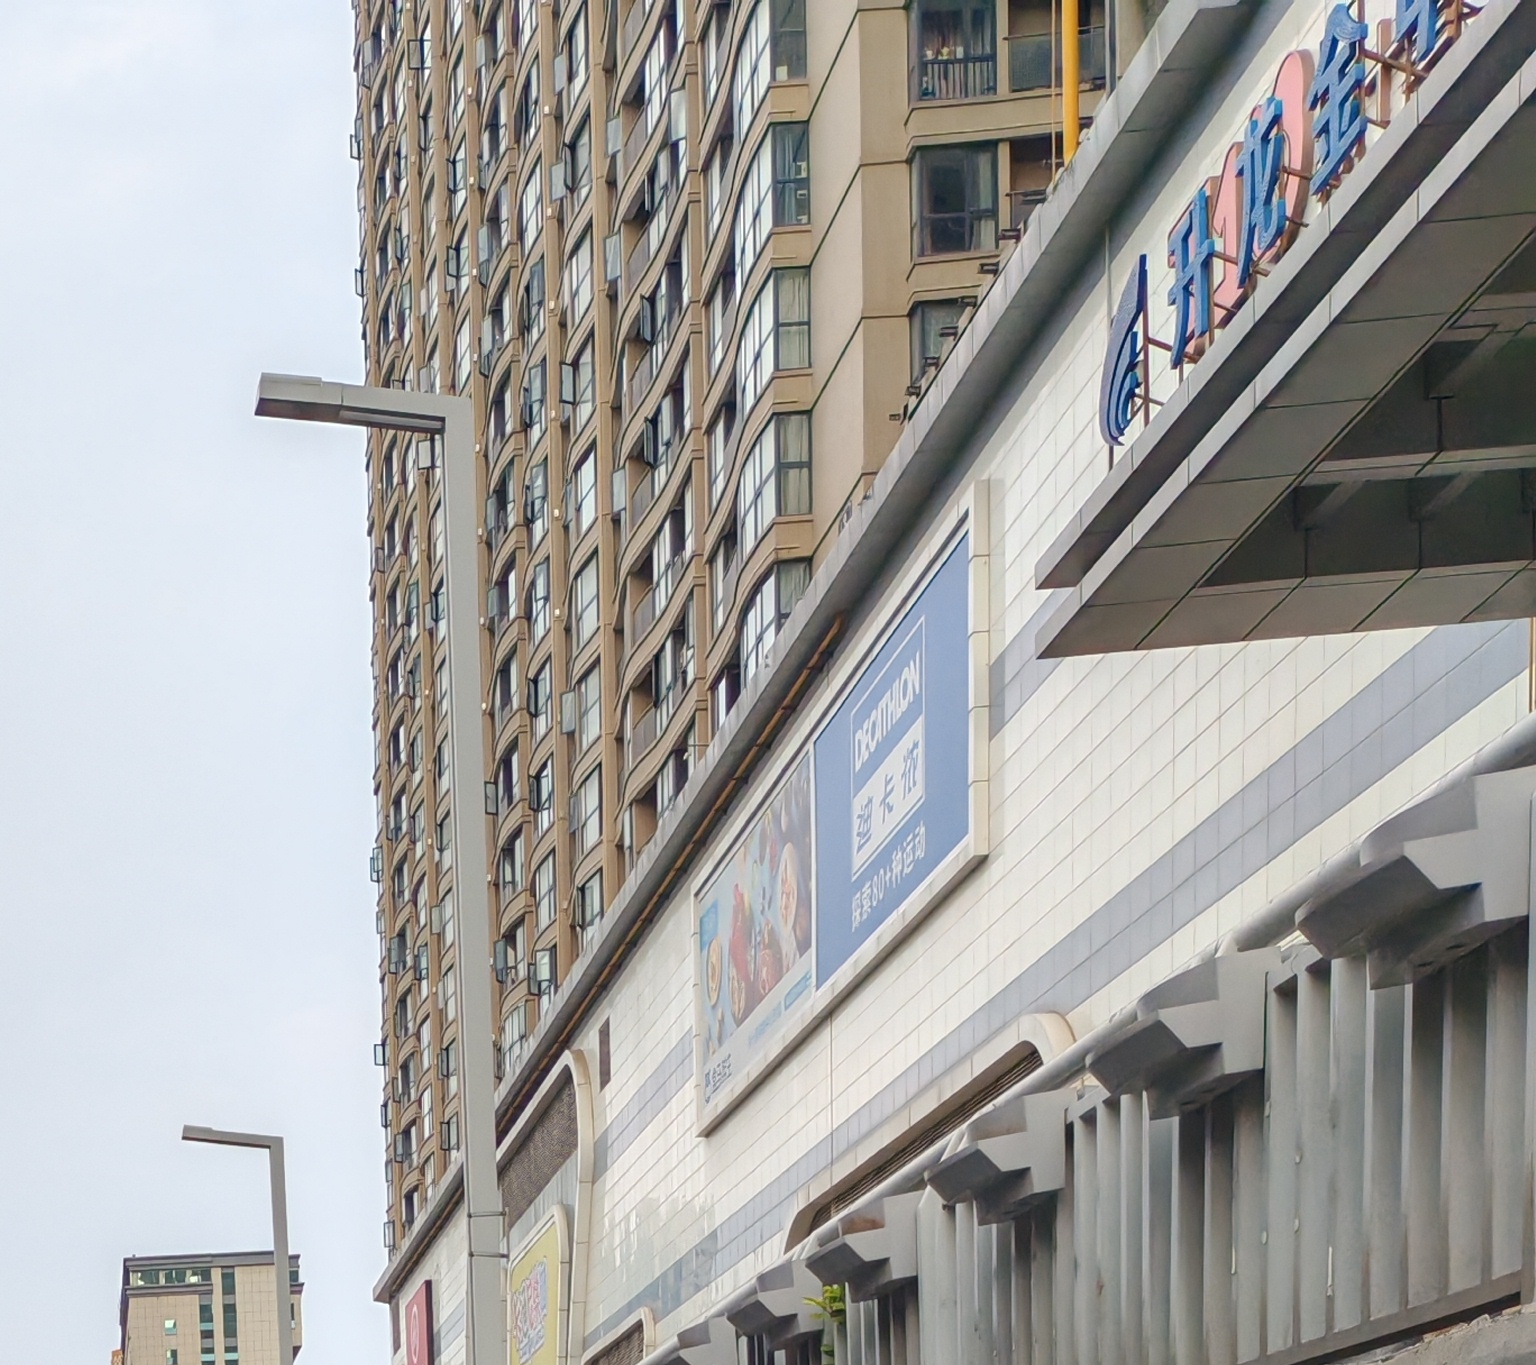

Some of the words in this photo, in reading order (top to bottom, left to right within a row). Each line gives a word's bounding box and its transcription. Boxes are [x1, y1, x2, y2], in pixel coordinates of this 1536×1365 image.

[855, 651, 920, 774] DECATHLON
[855, 739, 919, 855] 迪卡侬
